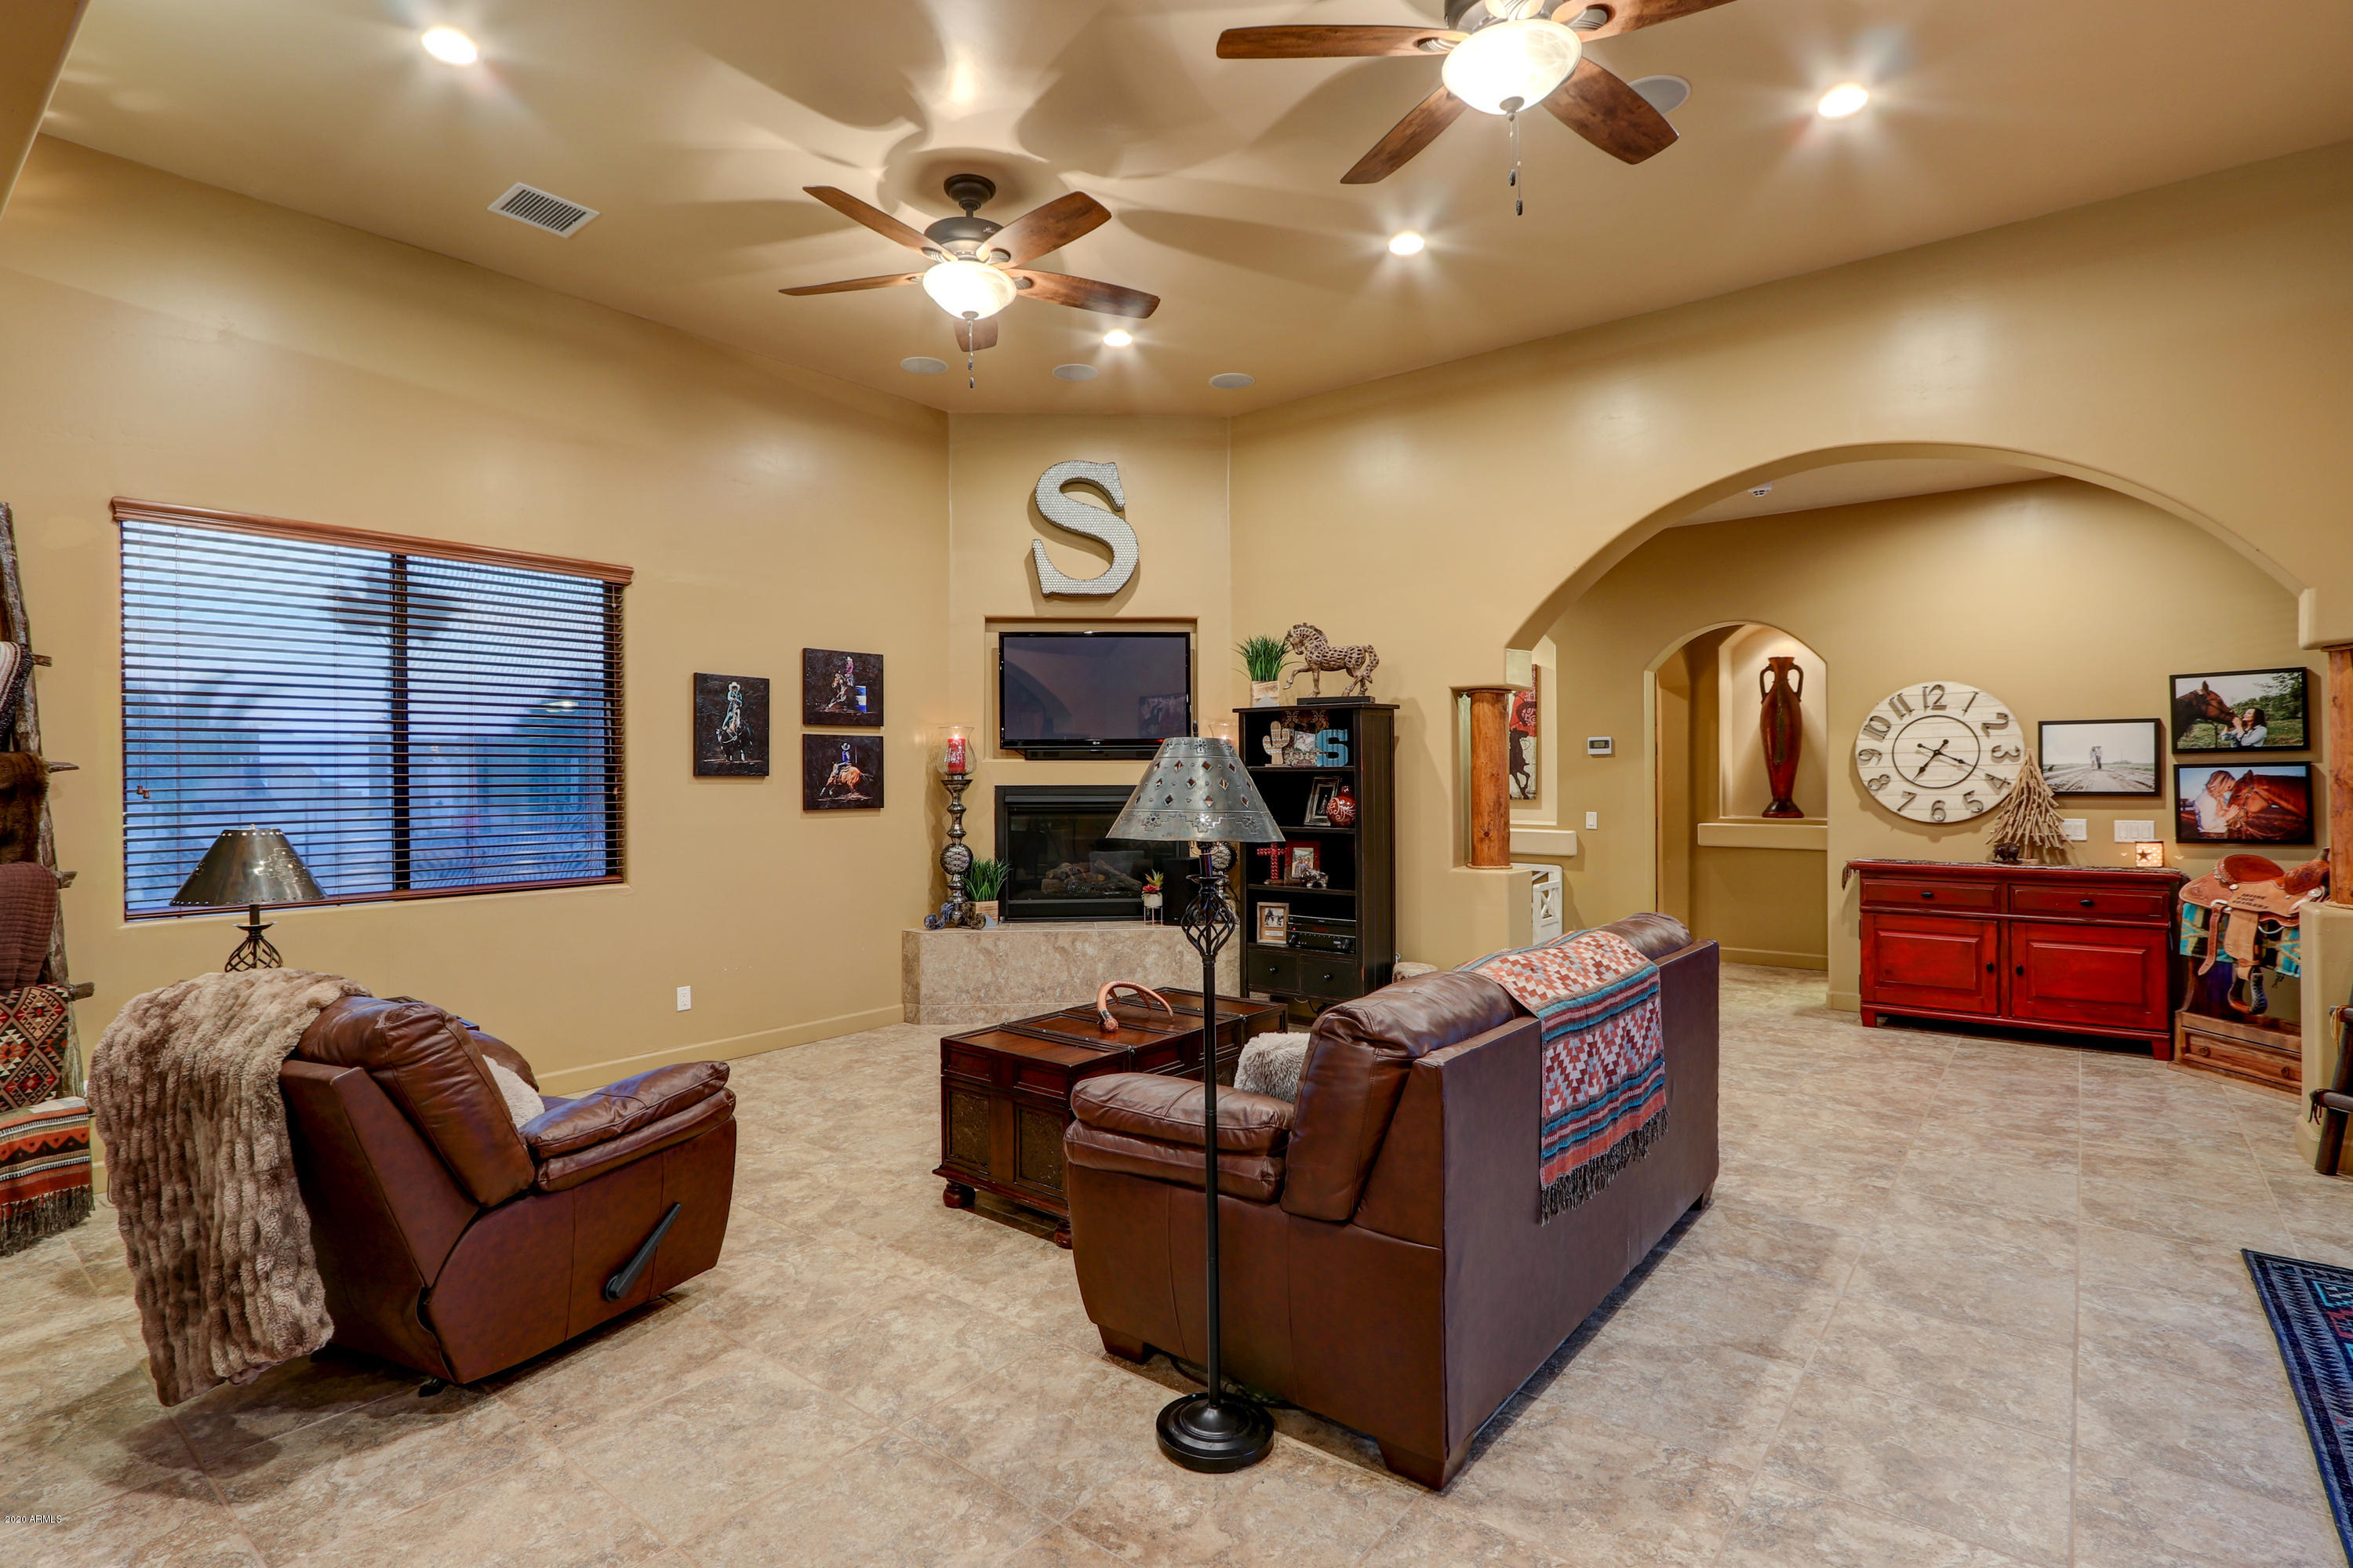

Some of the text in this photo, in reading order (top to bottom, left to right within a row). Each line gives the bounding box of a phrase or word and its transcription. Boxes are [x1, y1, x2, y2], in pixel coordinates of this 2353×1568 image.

[1031, 460, 1139, 598] S
[1888, 693, 1915, 720] 11
[1922, 684, 1947, 712] 12
[1962, 692, 1979, 716] 1
[1861, 715, 1891, 742] 10
[1981, 713, 2009, 738] 2
[1316, 729, 1348, 766] S
[1858, 748, 1882, 766] 9
[1991, 745, 2020, 763] 3
[1867, 774, 1891, 793] 8
[1984, 773, 2012, 795] 4
[1897, 791, 1917, 813] 7
[1931, 800, 1947, 822] 6
[1963, 790, 1984, 813] 5
